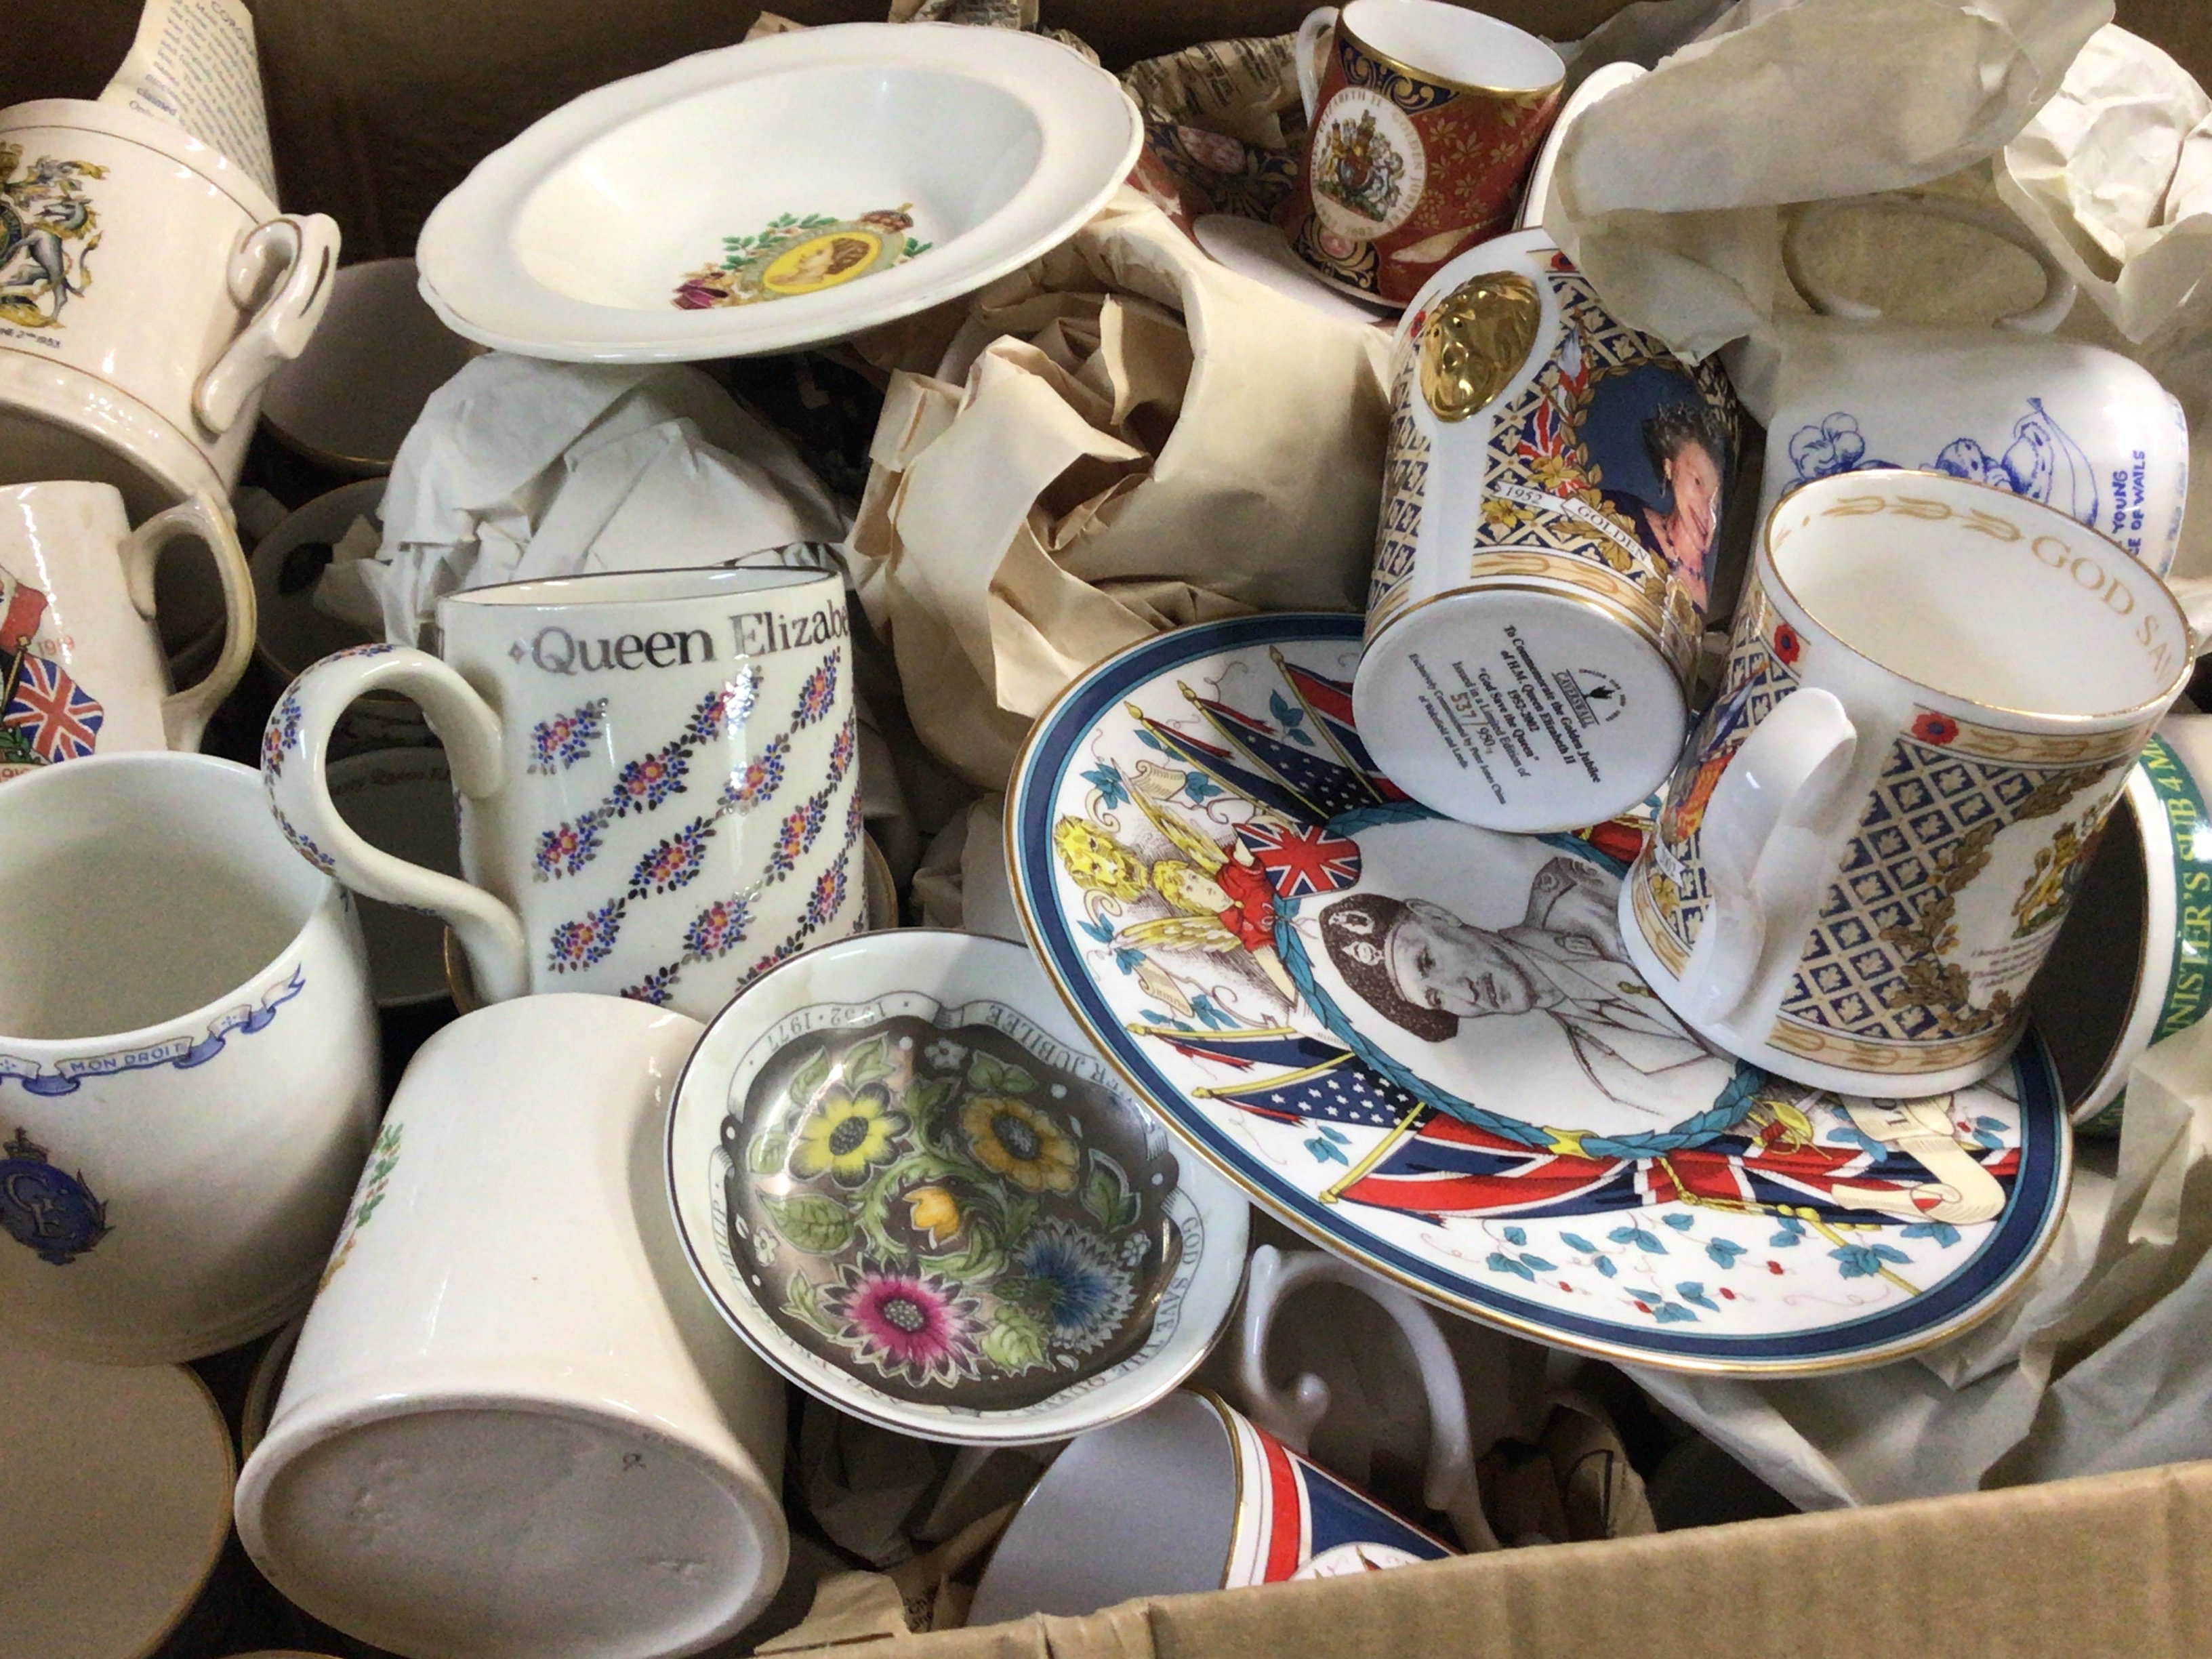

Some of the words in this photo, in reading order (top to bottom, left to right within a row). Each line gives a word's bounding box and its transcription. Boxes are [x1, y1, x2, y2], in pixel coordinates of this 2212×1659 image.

[1503, 483, 1543, 506] 1952
[1577, 505, 1651, 561] GOLDEN
[2112, 469, 2128, 534] YOUNG
[2130, 508, 2144, 531] OF
[2031, 535, 2136, 616] GOD
[531, 623, 718, 676] Queen
[1452, 661, 1476, 688] Issued
[1479, 704, 1505, 736] Limited
[1499, 736, 1521, 767] Edition
[1490, 691, 1508, 713] Save
[1503, 713, 1517, 728] the
[1507, 690, 1540, 732] 1952-2002
[1513, 638, 1555, 700] Commemorate
[1551, 701, 1564, 716] the
[1561, 717, 1583, 750] Golden
[1577, 751, 1600, 783] Jubilee
[1521, 684, 1544, 712] Queen
[1539, 713, 1569, 754] Elizabeth
[1444, 736, 1457, 749] and
[2158, 776, 2184, 792] 4
[764, 1010, 813, 1052] 1977
[985, 1003, 1086, 1077] JUBILEE
[70, 1057, 118, 1073] MON
[123, 1043, 183, 1068] DROIT
[1180, 1216, 1200, 1266] GOD
[1154, 1276, 1189, 1336] SAVE
